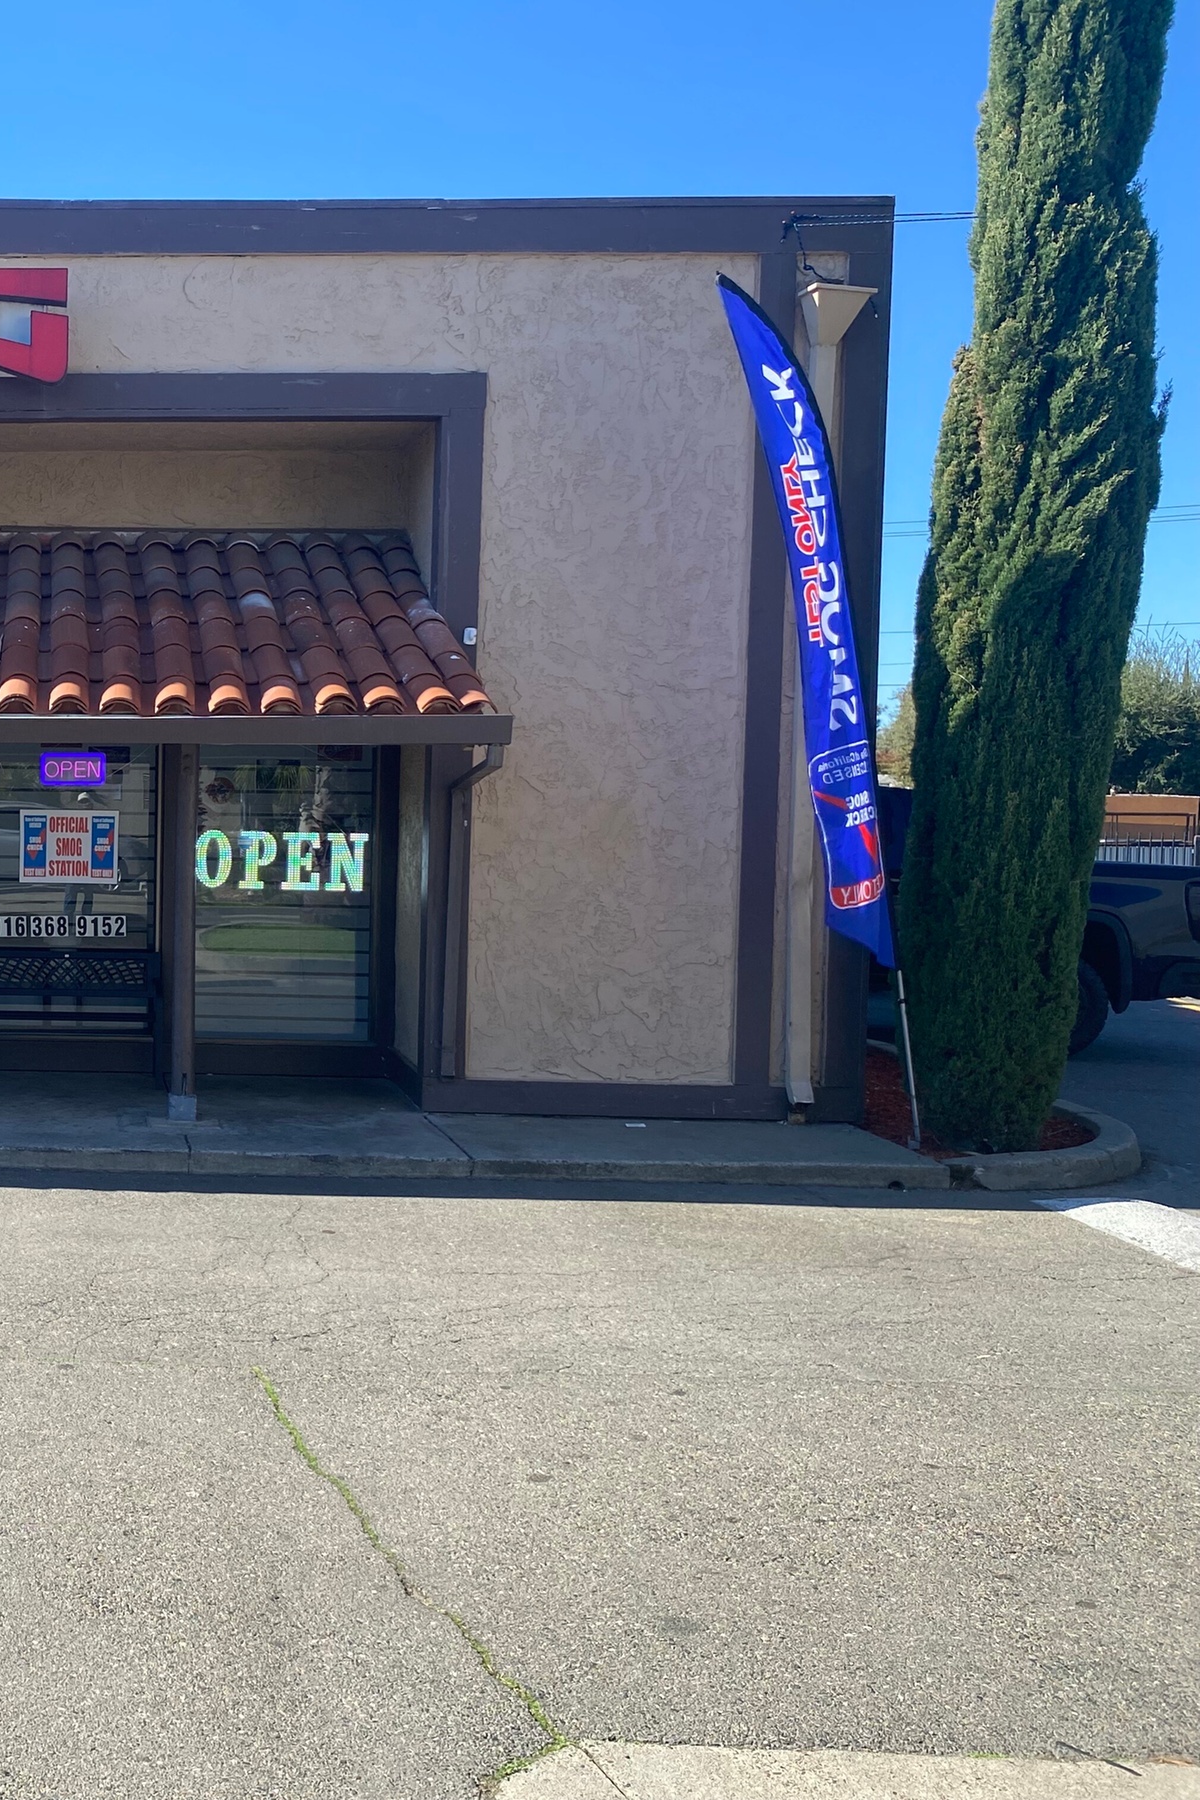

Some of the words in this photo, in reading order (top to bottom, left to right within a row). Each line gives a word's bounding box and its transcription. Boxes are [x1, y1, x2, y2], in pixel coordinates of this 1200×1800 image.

[44, 760, 101, 778] OPEN
[49, 816, 89, 833] OFFICIAL
[56, 838, 82, 856] SMOG
[49, 860, 89, 877] STATION
[195, 829, 369, 892] OPEN
[32, 916, 67, 937] 368
[77, 916, 125, 937] 9152
